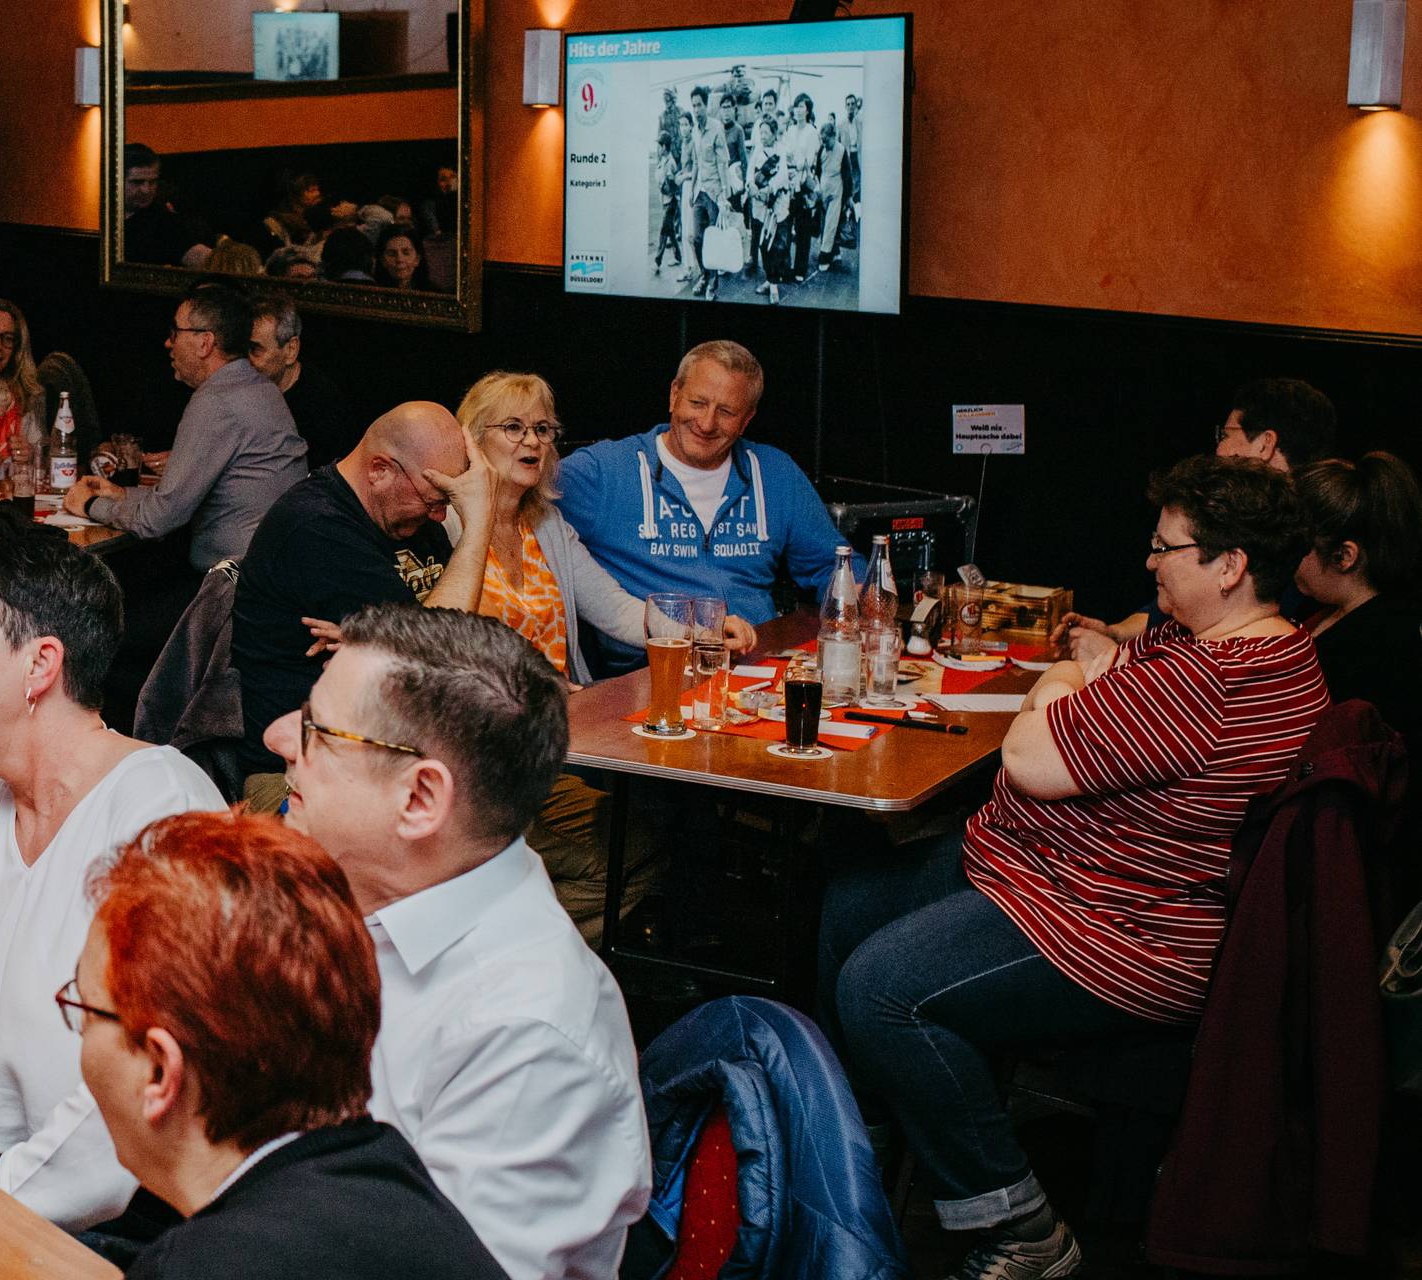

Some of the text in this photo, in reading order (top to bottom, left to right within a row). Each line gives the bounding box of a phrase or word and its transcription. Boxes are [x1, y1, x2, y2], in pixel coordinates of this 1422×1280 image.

[569, 39, 661, 57] Hits der Jahre
[581, 83, 598, 112] 9.
[570, 152, 607, 163] Runde 2
[570, 179, 601, 189] Kategorie
[570, 254, 604, 262] ANTENNE
[570, 274, 604, 284] DÜSSELDORF
[670, 523, 697, 539] REG
[651, 542, 671, 556] BAY
[673, 544, 698, 558] SWIM
